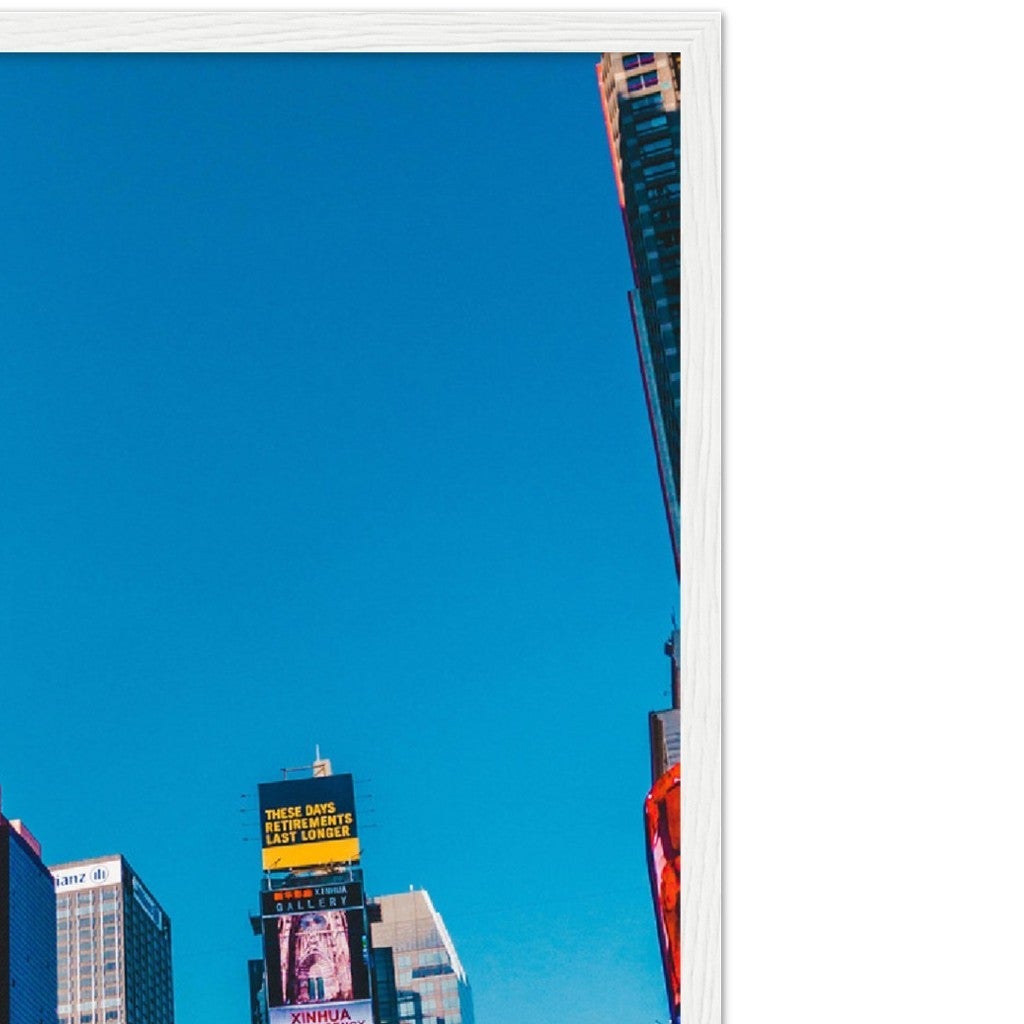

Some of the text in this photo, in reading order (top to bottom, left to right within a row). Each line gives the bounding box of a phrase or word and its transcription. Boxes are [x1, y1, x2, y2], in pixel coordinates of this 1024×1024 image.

[265, 802, 336, 820] THESE DAYS
[265, 813, 353, 833] RETIREMENTS
[266, 825, 351, 845] LAST LONGER
[276, 896, 347, 912] GALLERY
[291, 1008, 351, 1024] XINHUA
